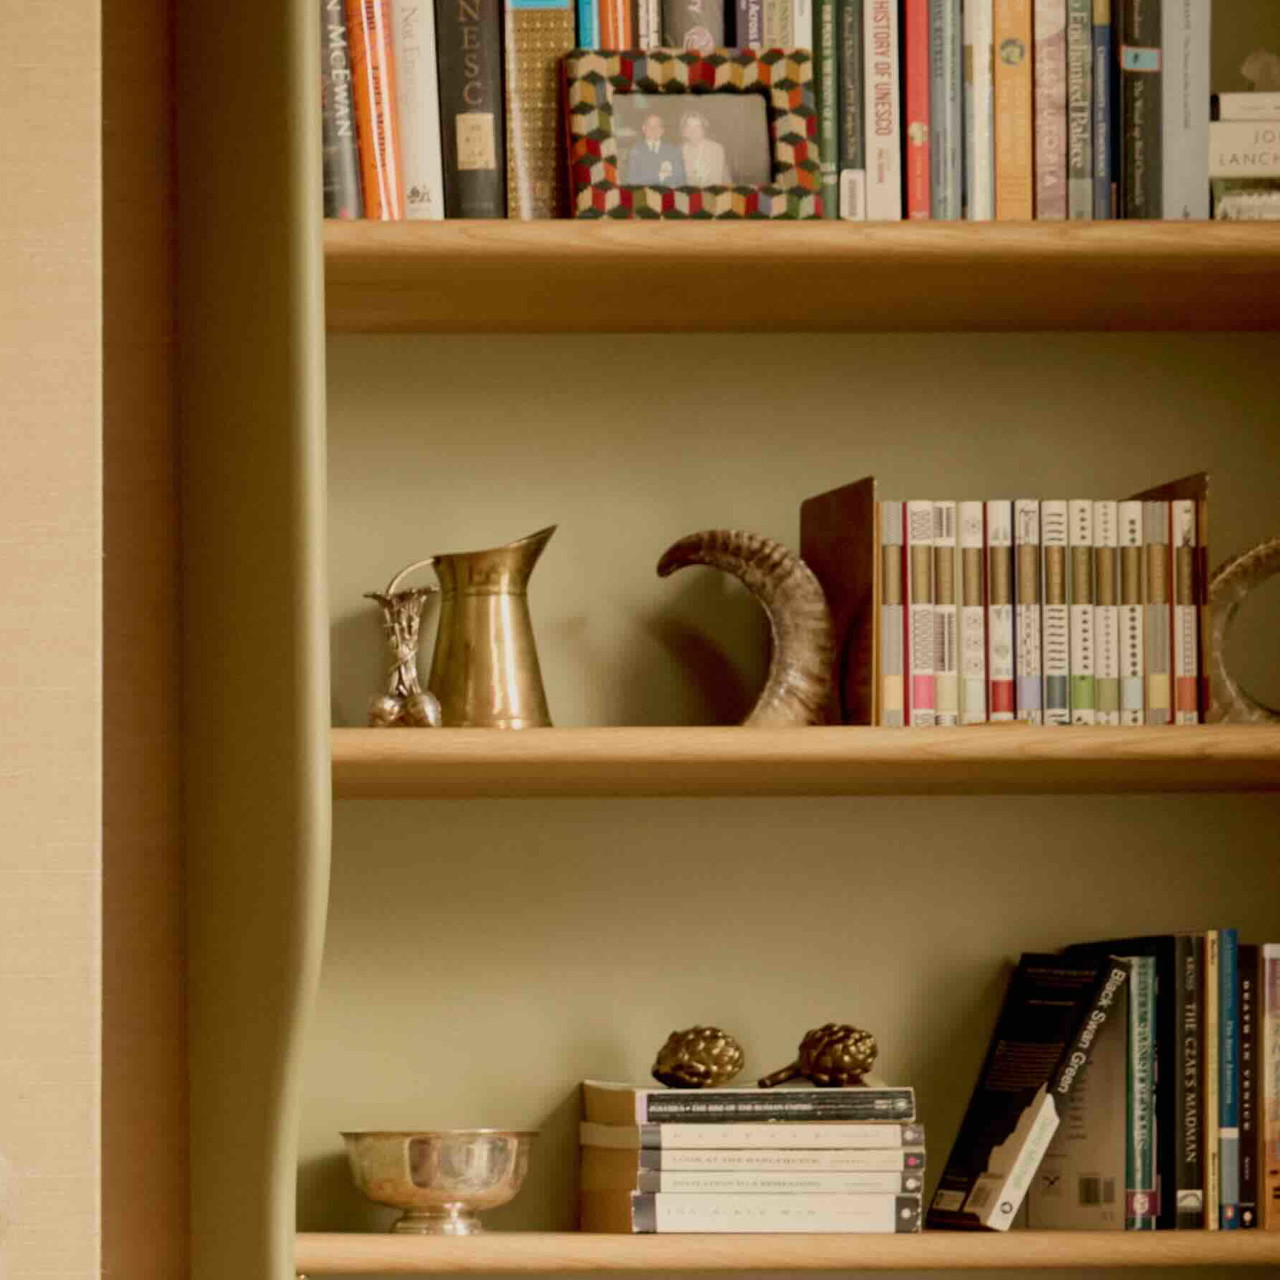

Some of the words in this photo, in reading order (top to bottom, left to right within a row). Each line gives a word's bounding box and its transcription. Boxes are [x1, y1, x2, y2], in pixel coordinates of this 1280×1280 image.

[873, 1, 893, 57] HISTORY
[874, 61, 893, 79] OF
[1069, 11, 1090, 107] Enchanted
[874, 82, 894, 137] UNESCO
[1043, 108, 1058, 187] UTOPIA
[1070, 111, 1089, 168] Palace
[1097, 968, 1127, 1008] Black
[1242, 980, 1251, 1034] DEATH
[1078, 1009, 1106, 1050] Swan
[1185, 1002, 1196, 1032] THE
[1057, 1051, 1086, 1094] Green
[1242, 1043, 1251, 1061] IN
[1242, 1069, 1251, 1132] VENICE
[1185, 1092, 1196, 1164] MADMAN
